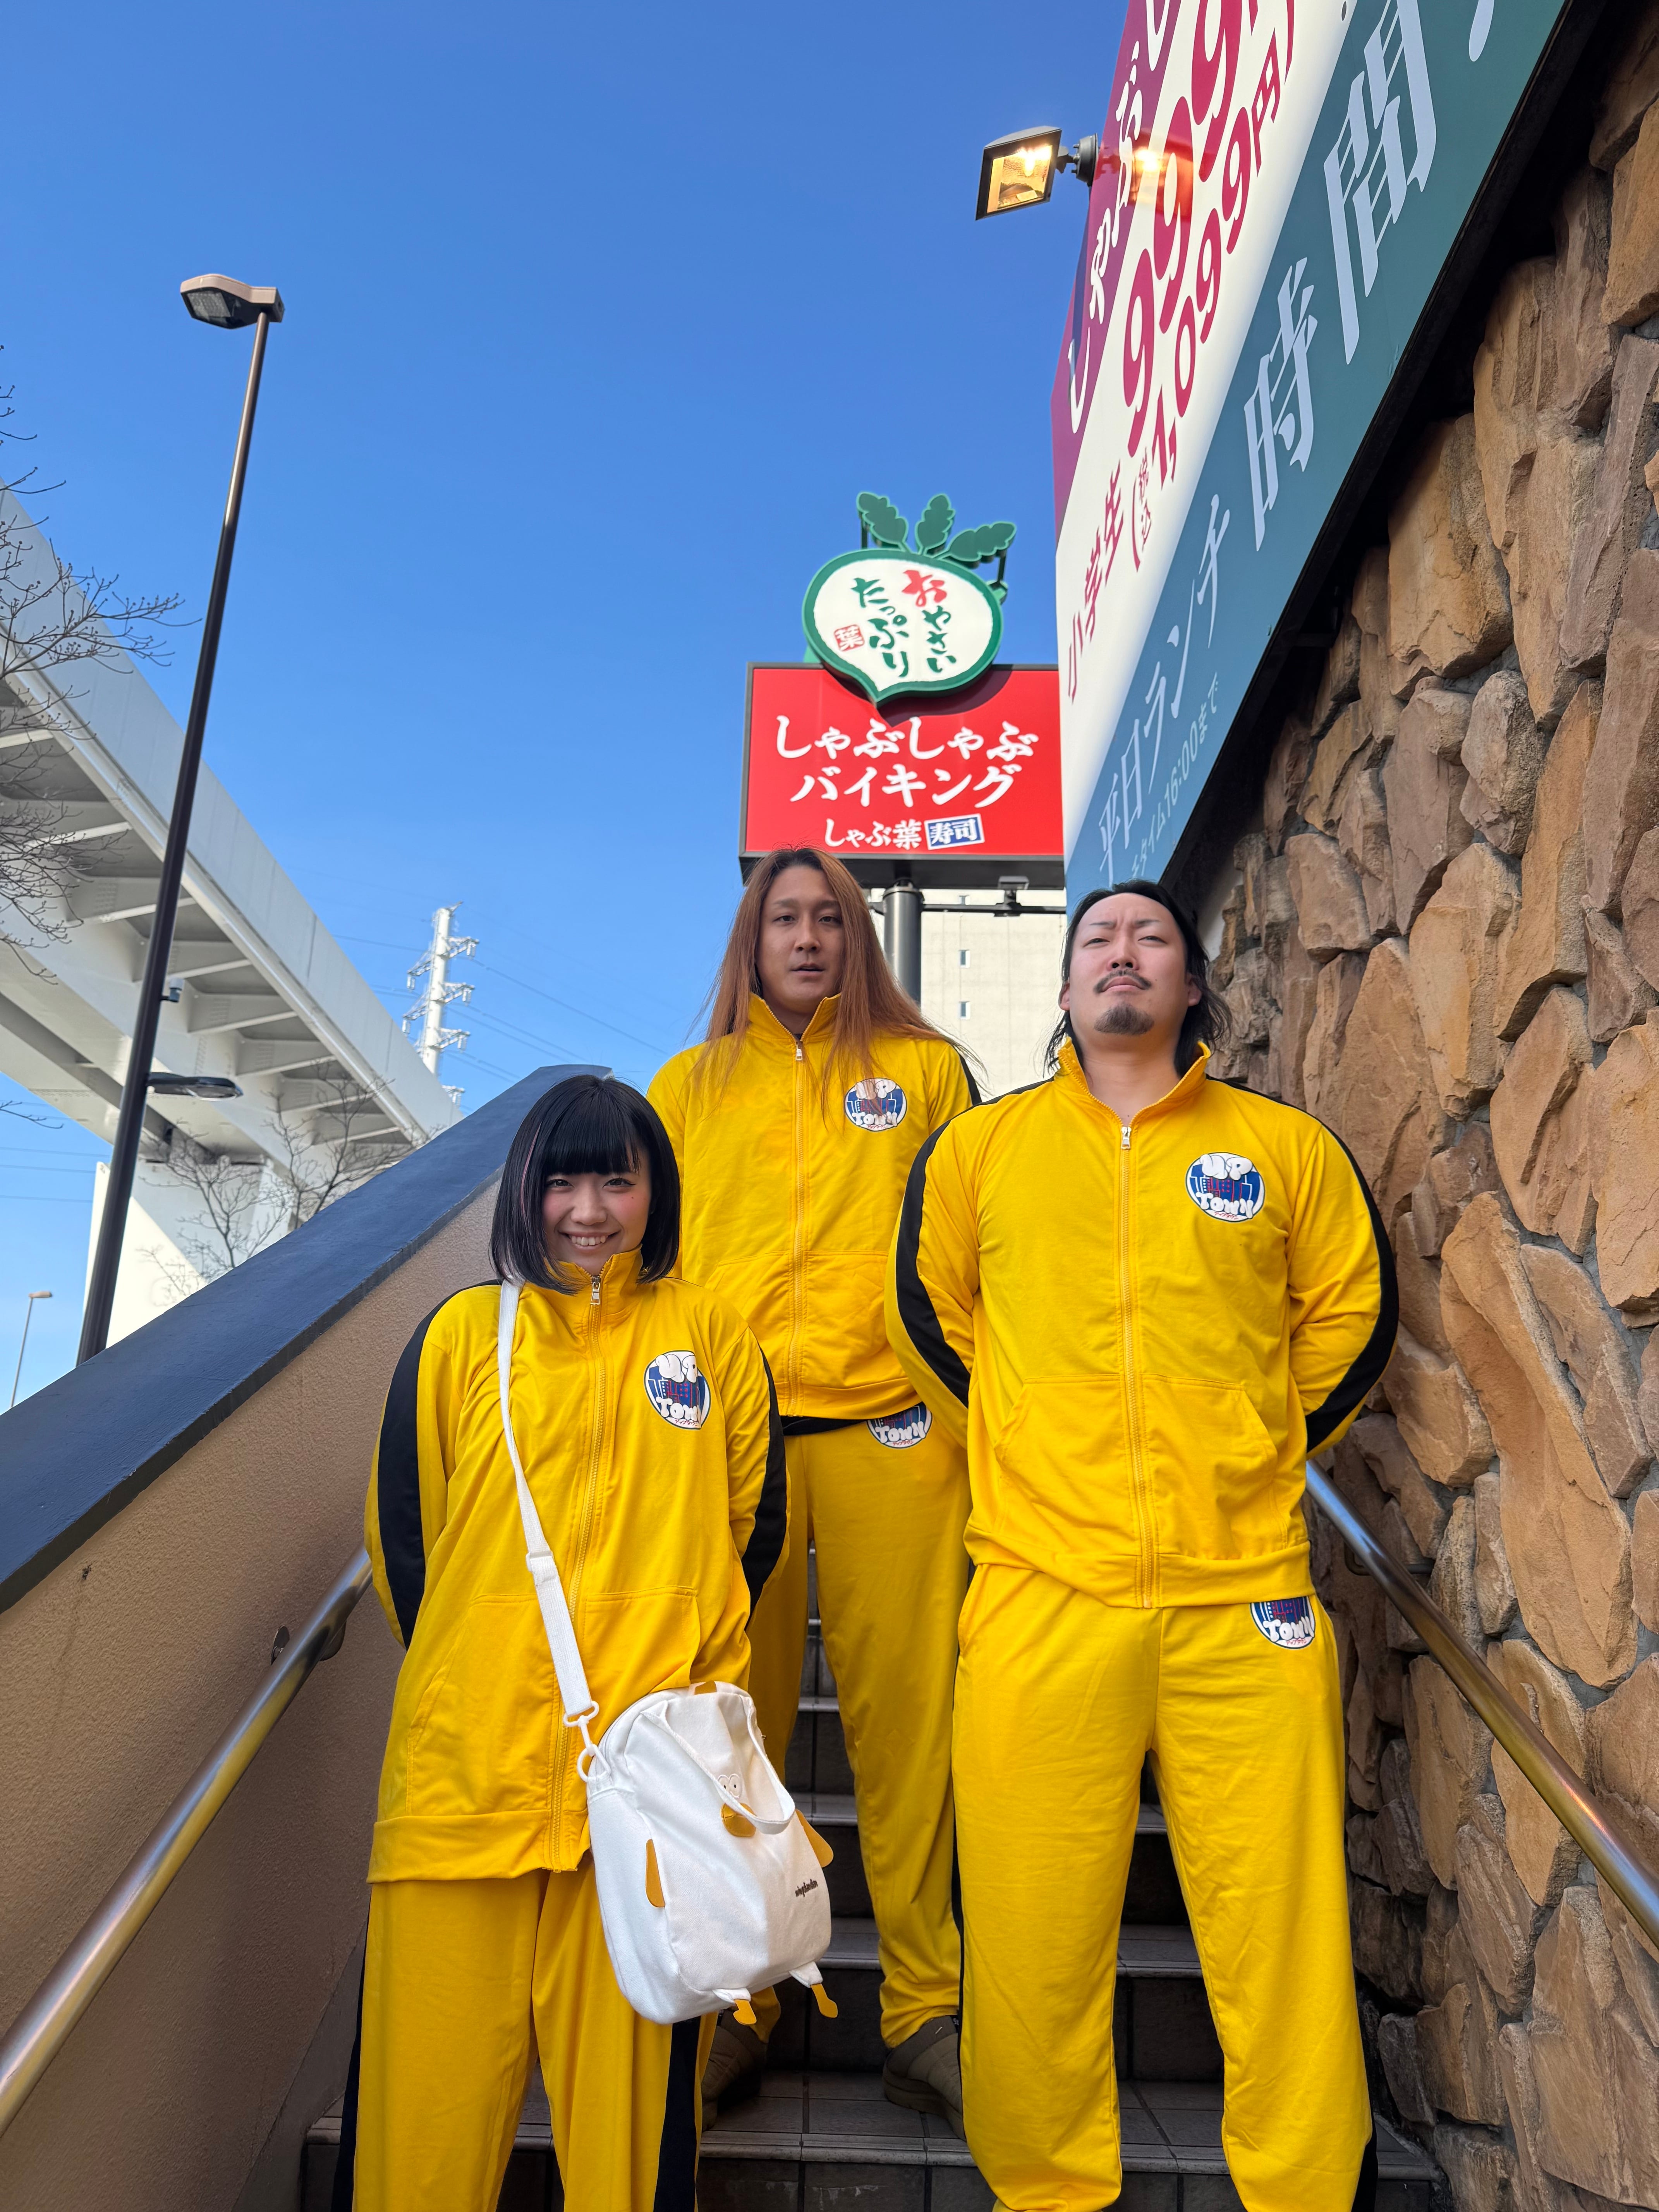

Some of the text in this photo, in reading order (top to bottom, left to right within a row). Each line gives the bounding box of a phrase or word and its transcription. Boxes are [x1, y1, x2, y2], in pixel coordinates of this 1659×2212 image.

[1068, 0, 1258, 706] 小学生 999
[1099, 0, 1495, 888] 平日ランチ時間
[850, 577, 910, 677] たっぷり
[902, 569, 956, 673] おやさい
[776, 715, 1039, 761] しゃぶしゃぶ
[789, 763, 1022, 808] バイキング
[824, 818, 978, 849] しゃぶ葉 寿司
[855, 1079, 897, 1100] UP
[852, 1111, 898, 1127] TOWN
[1199, 1154, 1253, 1180] UP
[1195, 1192, 1254, 1219] TOWN
[874, 1421, 926, 1444] TOWN
[1262, 1615, 1315, 1642] TOWN
